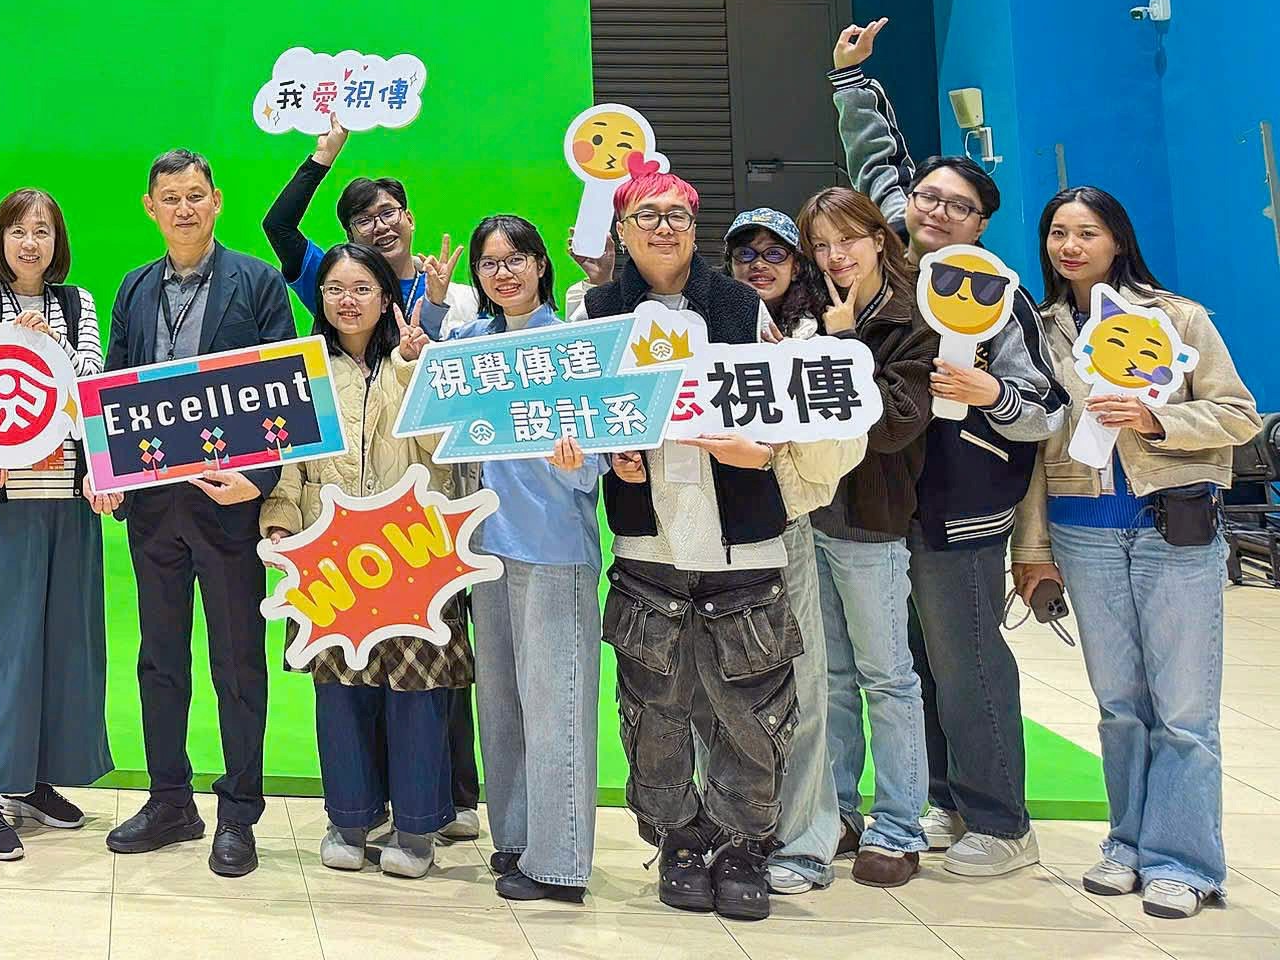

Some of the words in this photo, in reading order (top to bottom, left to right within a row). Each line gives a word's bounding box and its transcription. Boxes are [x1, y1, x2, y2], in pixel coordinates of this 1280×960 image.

[276, 77, 409, 115] 我愛視傳
[426, 339, 602, 400] 視覺傳達
[102, 370, 312, 437] Excellent
[509, 391, 648, 442] 設計系
[285, 504, 455, 628] WOW
